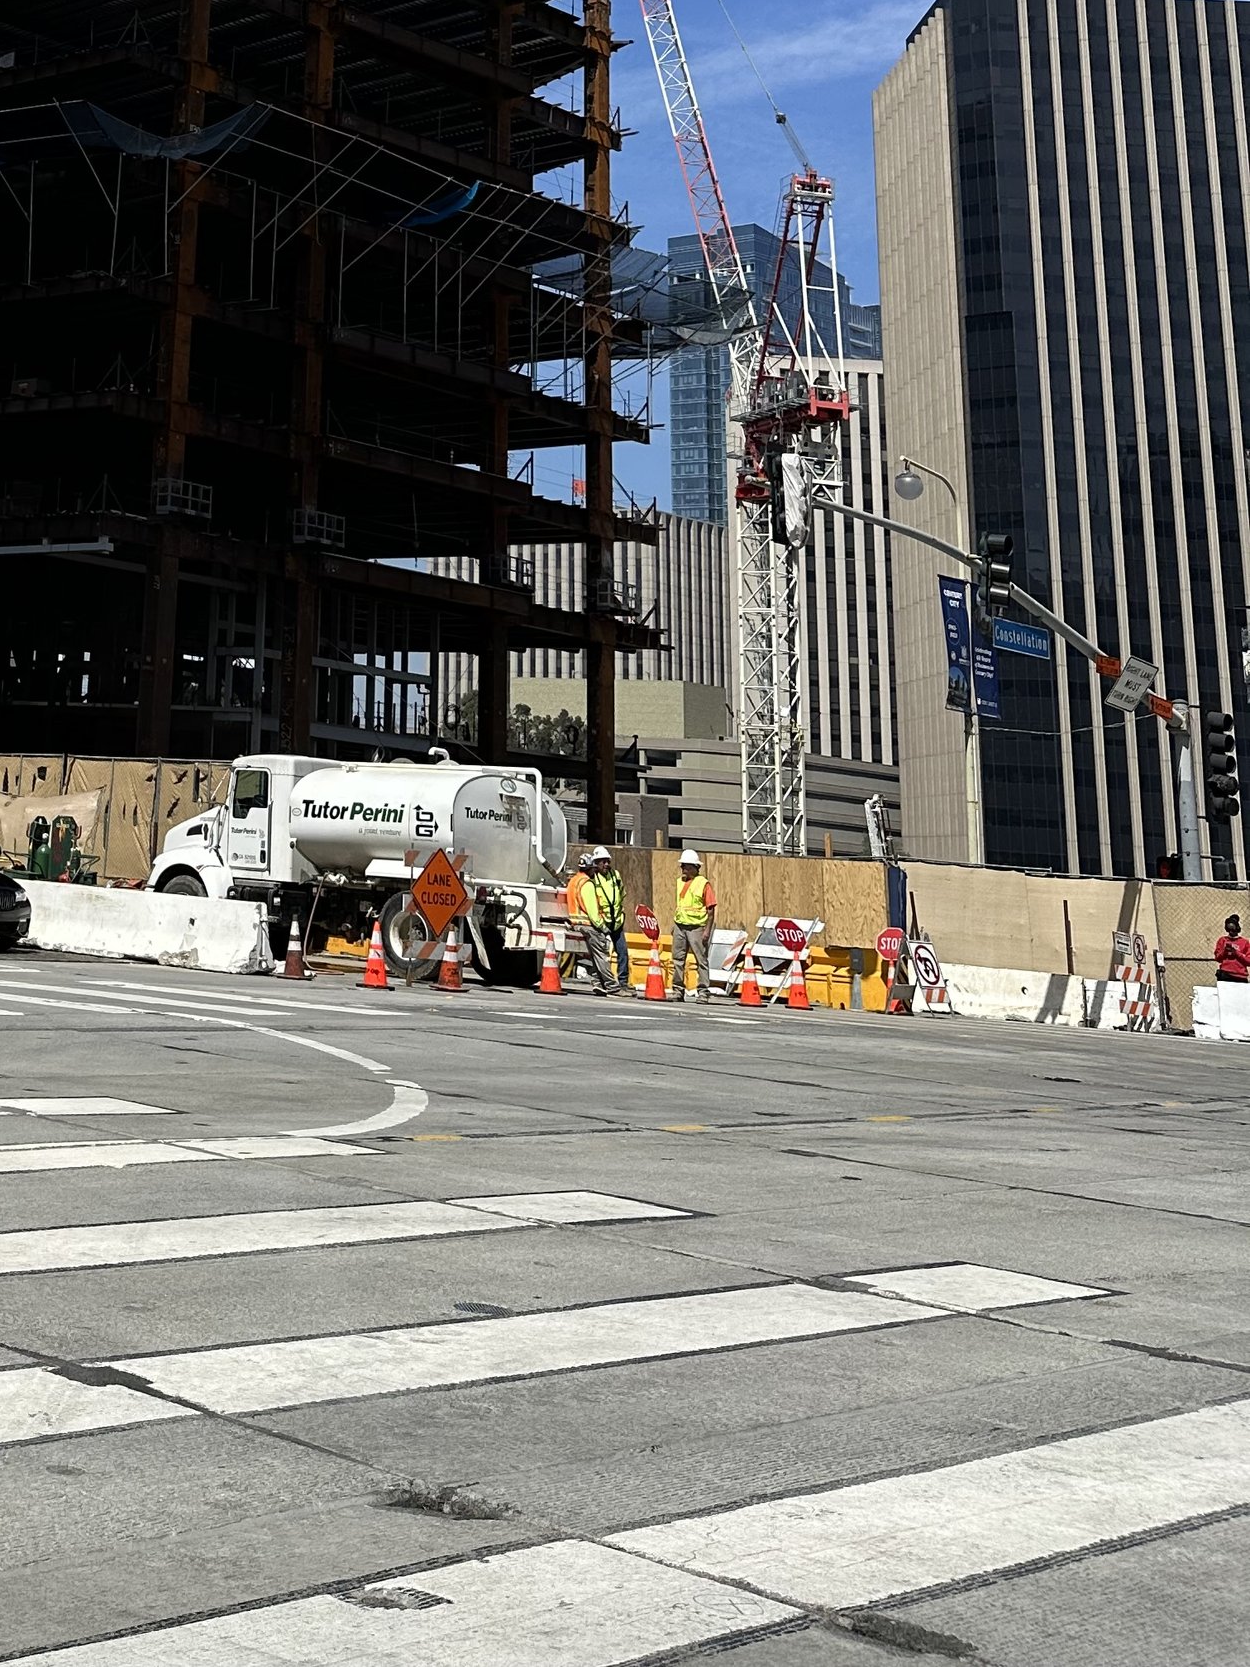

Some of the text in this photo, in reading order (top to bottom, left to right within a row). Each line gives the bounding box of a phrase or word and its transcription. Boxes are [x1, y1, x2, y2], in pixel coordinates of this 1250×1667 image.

[995, 626, 1047, 651] Constellation
[427, 873, 452, 887] LANE
[421, 891, 457, 907] CLOSED
[638, 914, 658, 931] STOP
[776, 927, 804, 943] STOP
